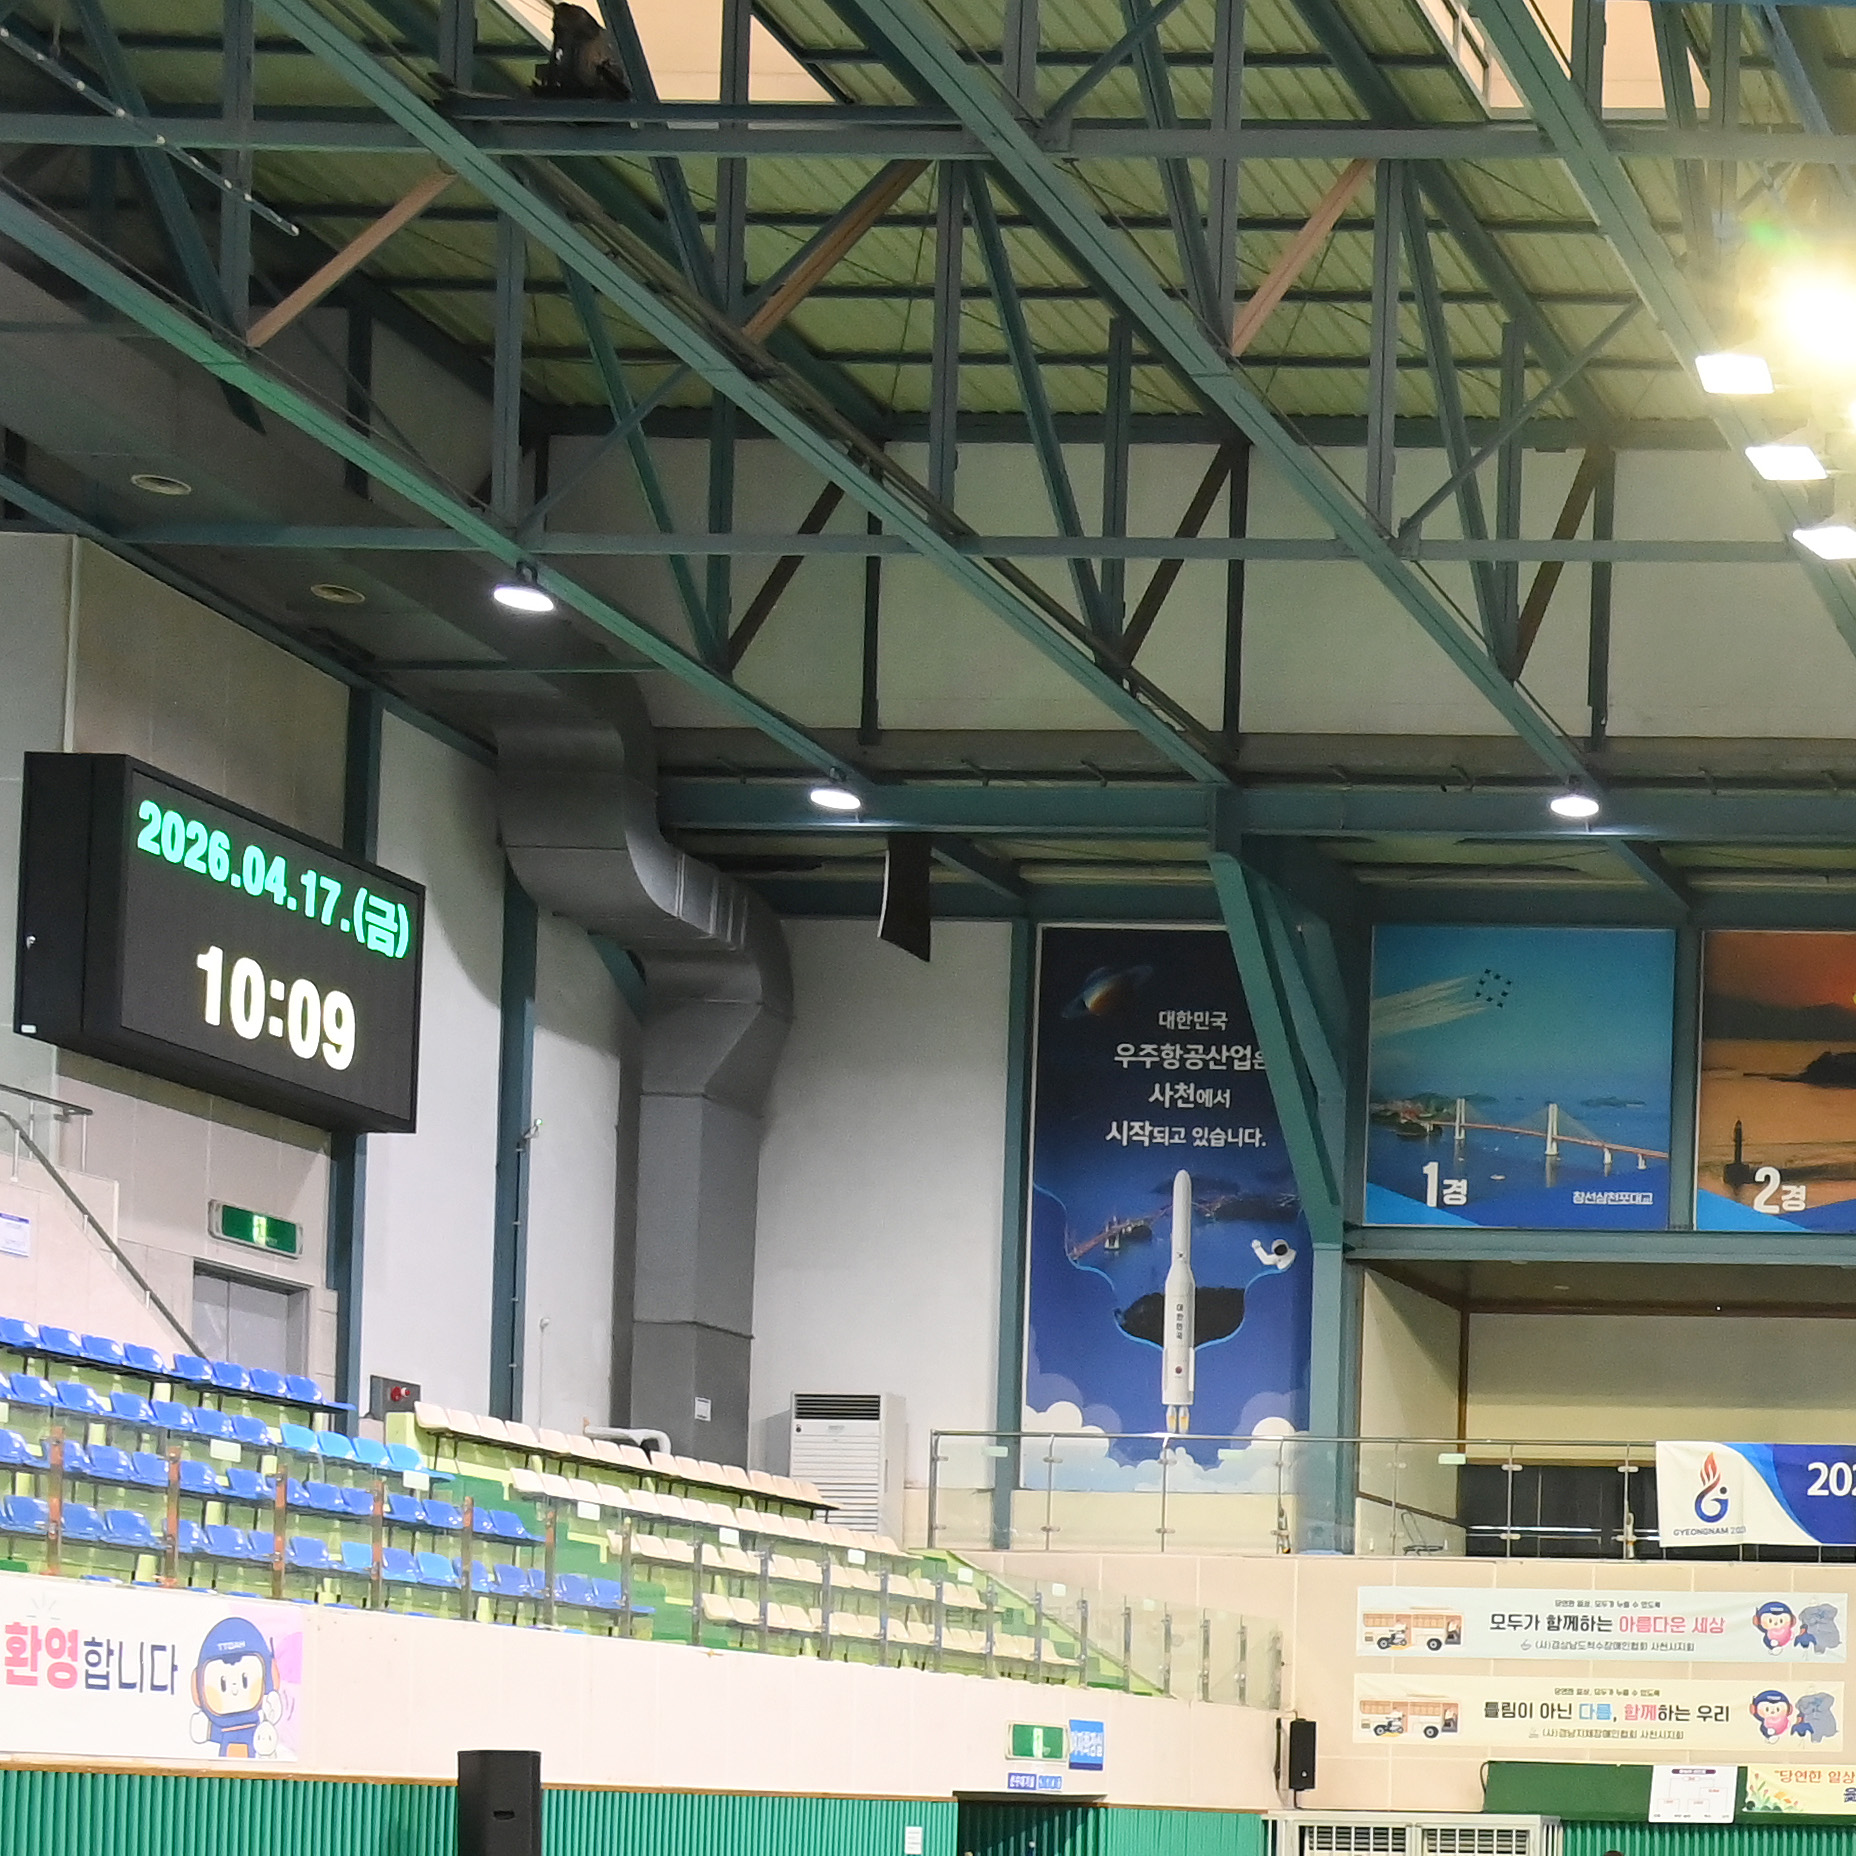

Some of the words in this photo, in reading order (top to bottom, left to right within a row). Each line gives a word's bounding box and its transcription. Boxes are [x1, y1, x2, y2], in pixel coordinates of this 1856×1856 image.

[138, 800, 410, 959] 2026.04.17.(금)
[195, 945, 356, 1071] 10:09
[1158, 1011, 1228, 1030] 대한민국
[1148, 1083, 1231, 1109] 사천에서
[1106, 1120, 1186, 1147] 시작되고
[1192, 1127, 1267, 1147] 있습니다.
[1423, 1162, 1468, 1207] 1경
[1754, 1167, 1806, 1214] 2경
[1490, 1613, 1540, 1633] 모두가
[1546, 1614, 1613, 1633] 함께하는
[1619, 1615, 1686, 1634] 아름다운
[1692, 1616, 1725, 1634] 세상
[4, 1621, 179, 1696] 환영합니다
[1484, 1701, 1534, 1719] 틀림이
[1539, 1702, 1573, 1721] 아닌
[1578, 1703, 1617, 1724] 다름,
[1624, 1704, 1690, 1722] 함께하는
[1696, 1705, 1729, 1723] 우리
